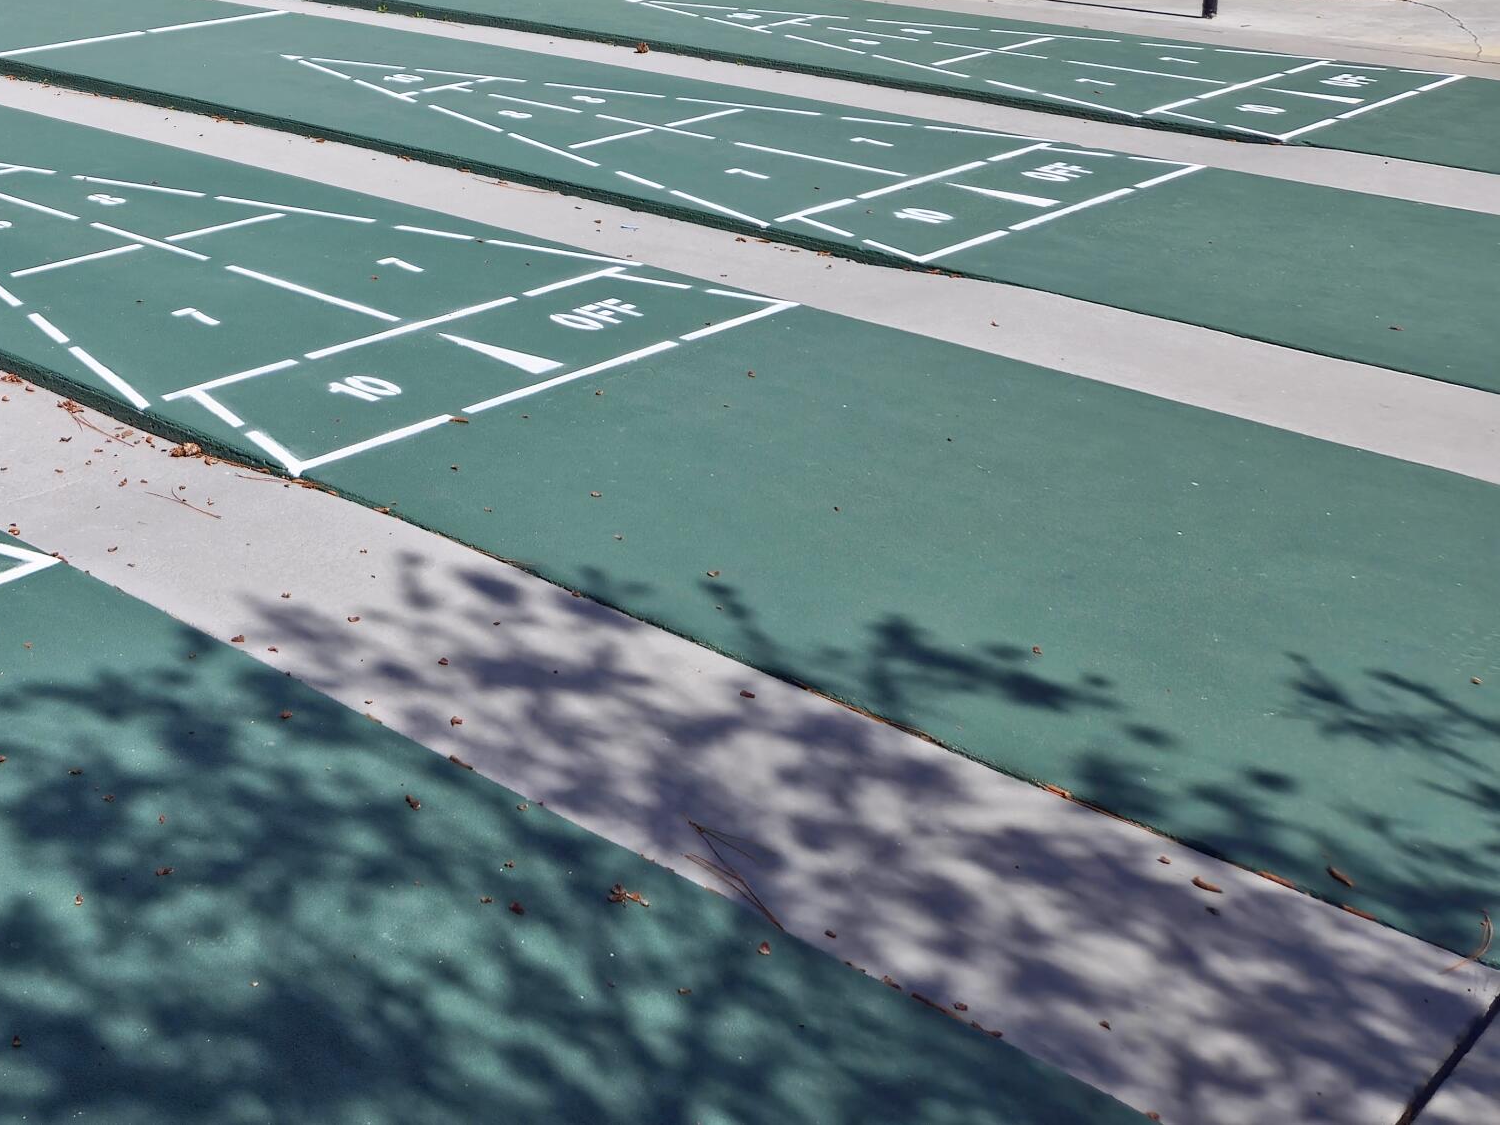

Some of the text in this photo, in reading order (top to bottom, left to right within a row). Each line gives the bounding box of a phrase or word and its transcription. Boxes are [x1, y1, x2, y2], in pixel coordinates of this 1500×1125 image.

[382, 72, 426, 84] 10
[1320, 74, 1377, 87] OFF
[1235, 104, 1286, 115] 10
[1022, 162, 1092, 181] OFF
[87, 193, 127, 205] 8
[894, 208, 953, 223] 10
[377, 258, 424, 272] 7
[172, 308, 220, 325] 7
[550, 298, 643, 330] OFF
[329, 376, 401, 401] 10
